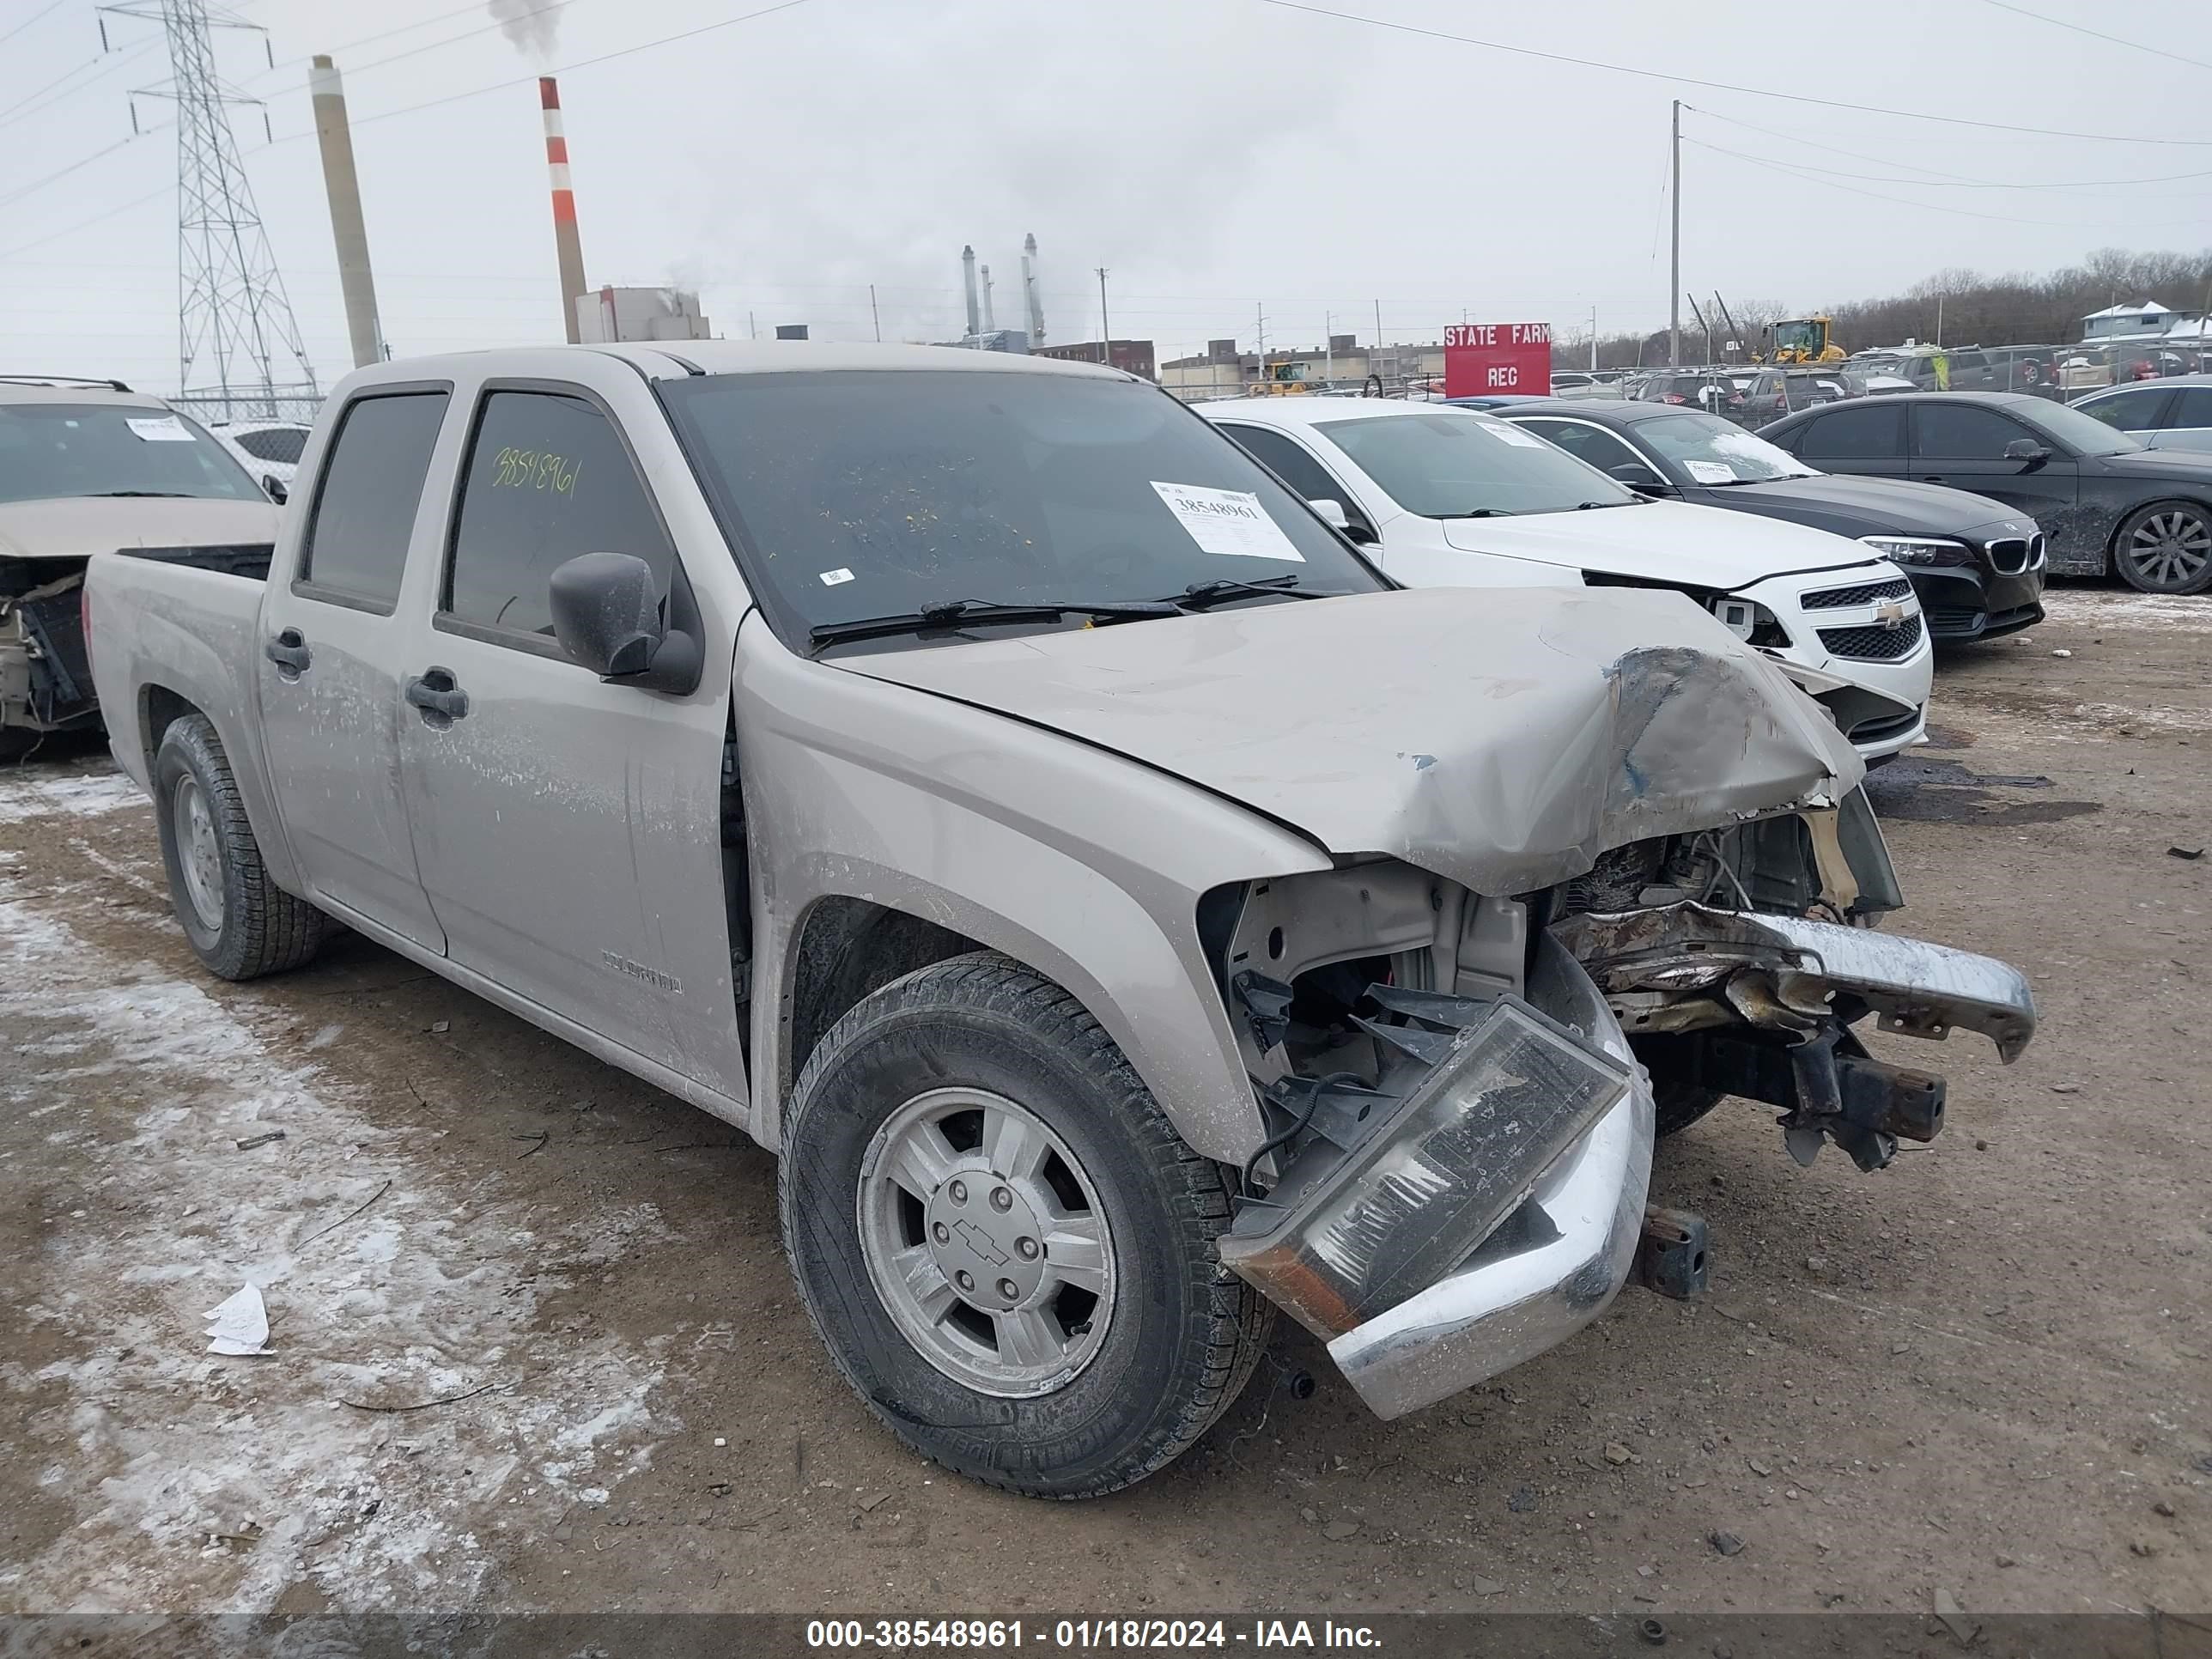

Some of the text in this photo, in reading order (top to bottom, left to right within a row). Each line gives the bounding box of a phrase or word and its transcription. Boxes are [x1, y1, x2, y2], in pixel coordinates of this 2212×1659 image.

[1445, 324, 1551, 347] STATE FARM
[1488, 367, 1517, 387] REG
[493, 447, 583, 501] 38548961
[1175, 497, 1260, 520] 38548961
